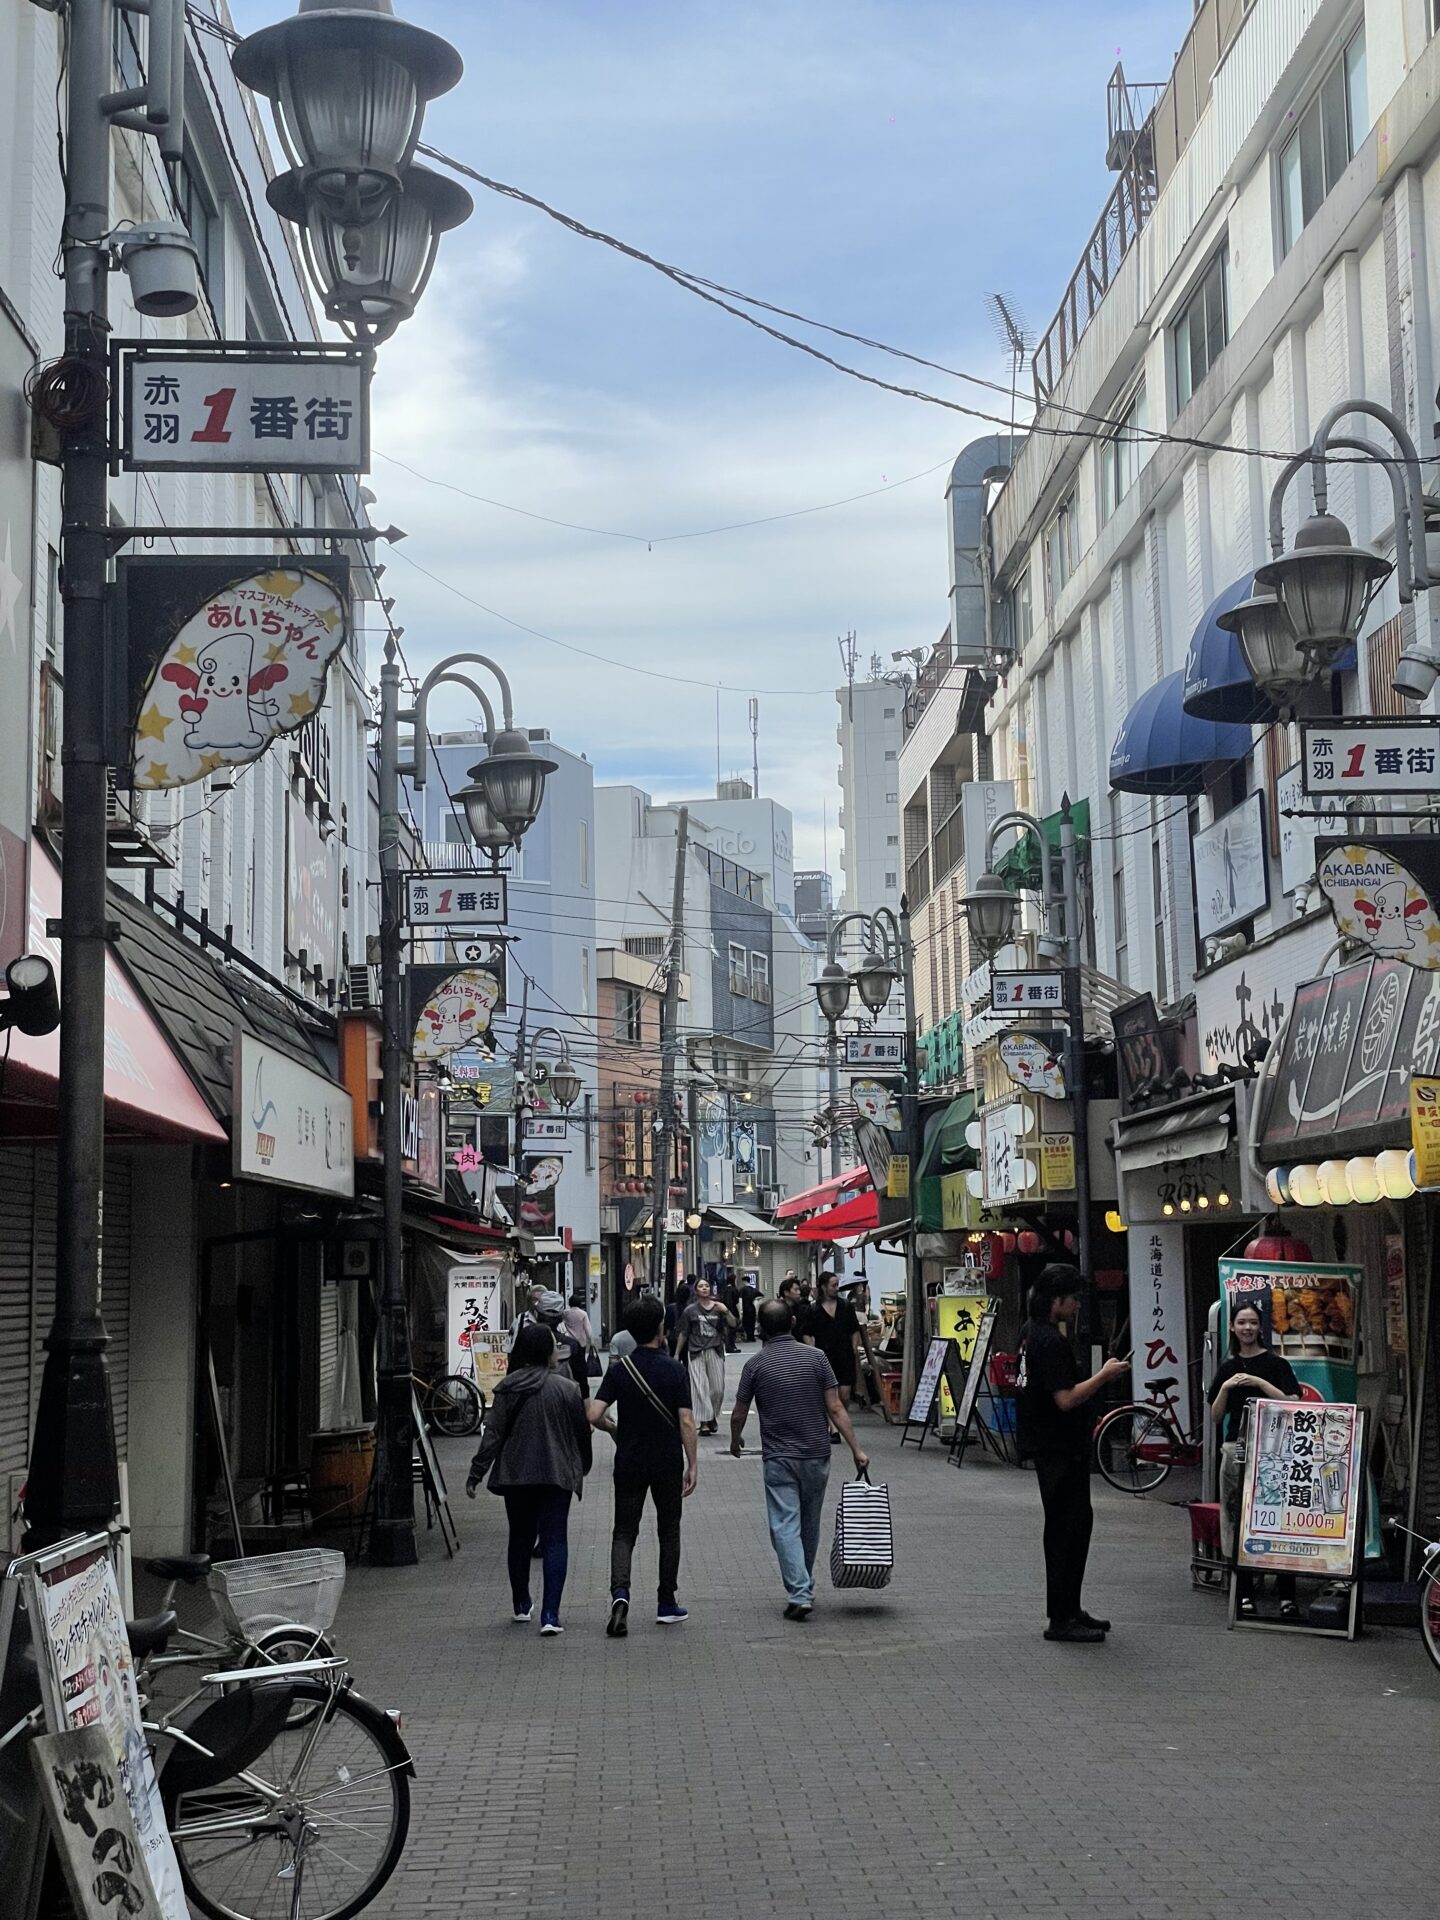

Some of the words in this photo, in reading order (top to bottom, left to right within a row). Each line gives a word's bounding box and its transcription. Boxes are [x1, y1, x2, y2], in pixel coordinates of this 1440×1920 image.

[237, 589, 331, 635] マスコットキャラクター
[207, 603, 321, 660] あいちゃん
[1322, 863, 1396, 876] AKABANE
[1323, 877, 1382, 888] ICHIBANGAI
[442, 983, 492, 1008] あいちゃん
[460, 1153, 476, 1166] 肉
[1149, 1234, 1166, 1332] 北海道らーめん
[1287, 1409, 1318, 1509] 飲み放題
[1286, 1511, 1335, 1529] 1,000円
